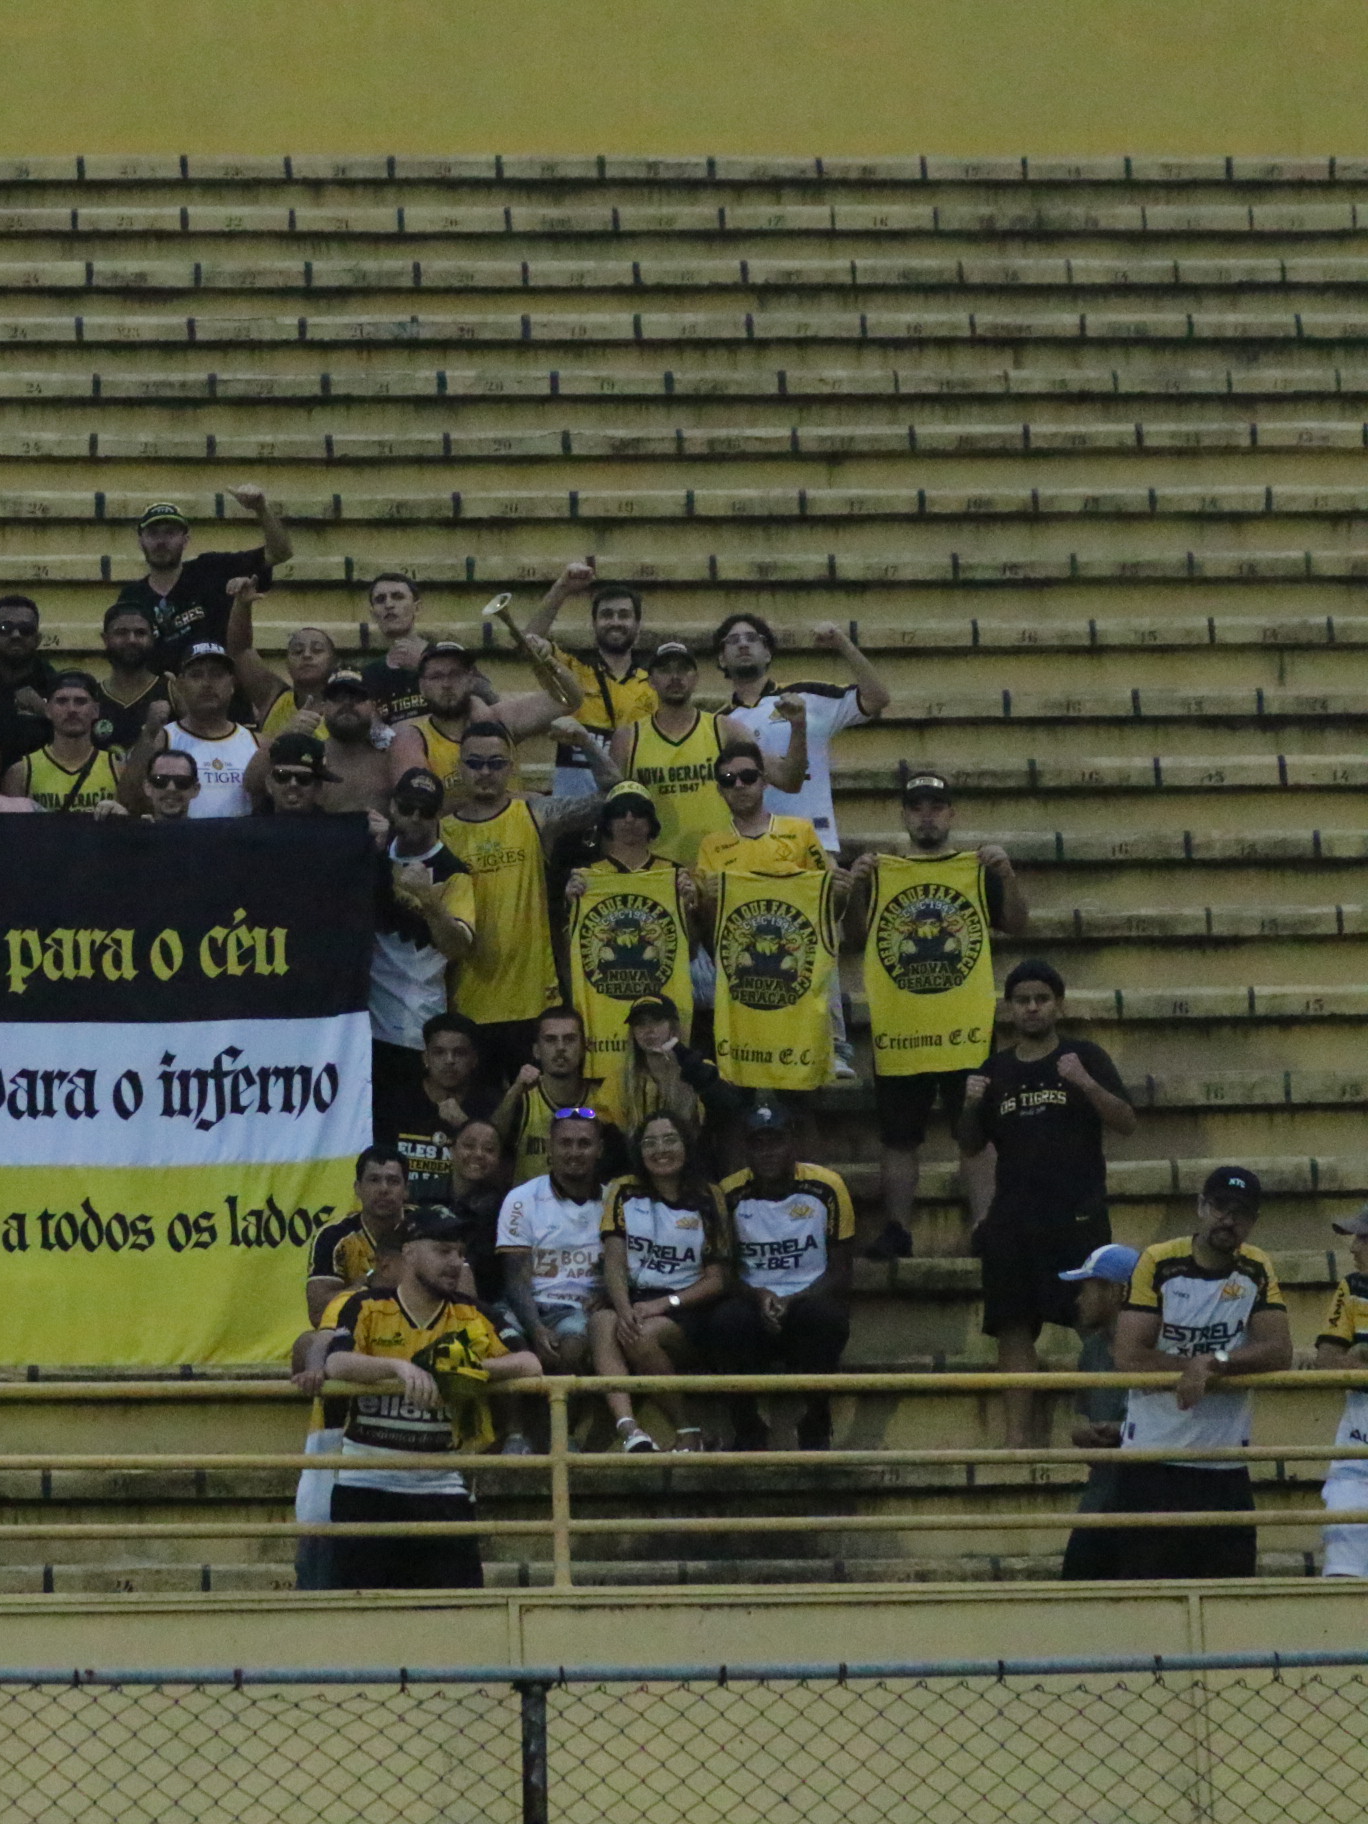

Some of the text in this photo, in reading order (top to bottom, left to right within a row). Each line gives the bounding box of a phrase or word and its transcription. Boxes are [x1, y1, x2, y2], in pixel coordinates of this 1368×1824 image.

[637, 767, 666, 784] NOVA
[3, 927, 139, 995] para
[150, 928, 183, 982] o
[199, 907, 290, 979] céu
[607, 969, 649, 983] NOVA
[909, 961, 950, 976] NOVA
[744, 976, 785, 992] NOVA
[112, 1068, 144, 1121] o
[156, 1045, 339, 1132] inferno
[1000, 1097, 1016, 1115] OS
[1020, 1090, 1067, 1107] TIGRES
[2, 1213, 30, 1252] a
[36, 1196, 156, 1252] todos
[167, 1210, 218, 1253] os
[627, 1234, 696, 1264] ESTRELA
[737, 1234, 818, 1257] ESTRELA
[647, 1257, 680, 1274] BET
[768, 1253, 803, 1270] BET
[1162, 1319, 1246, 1343] ESTRELA
